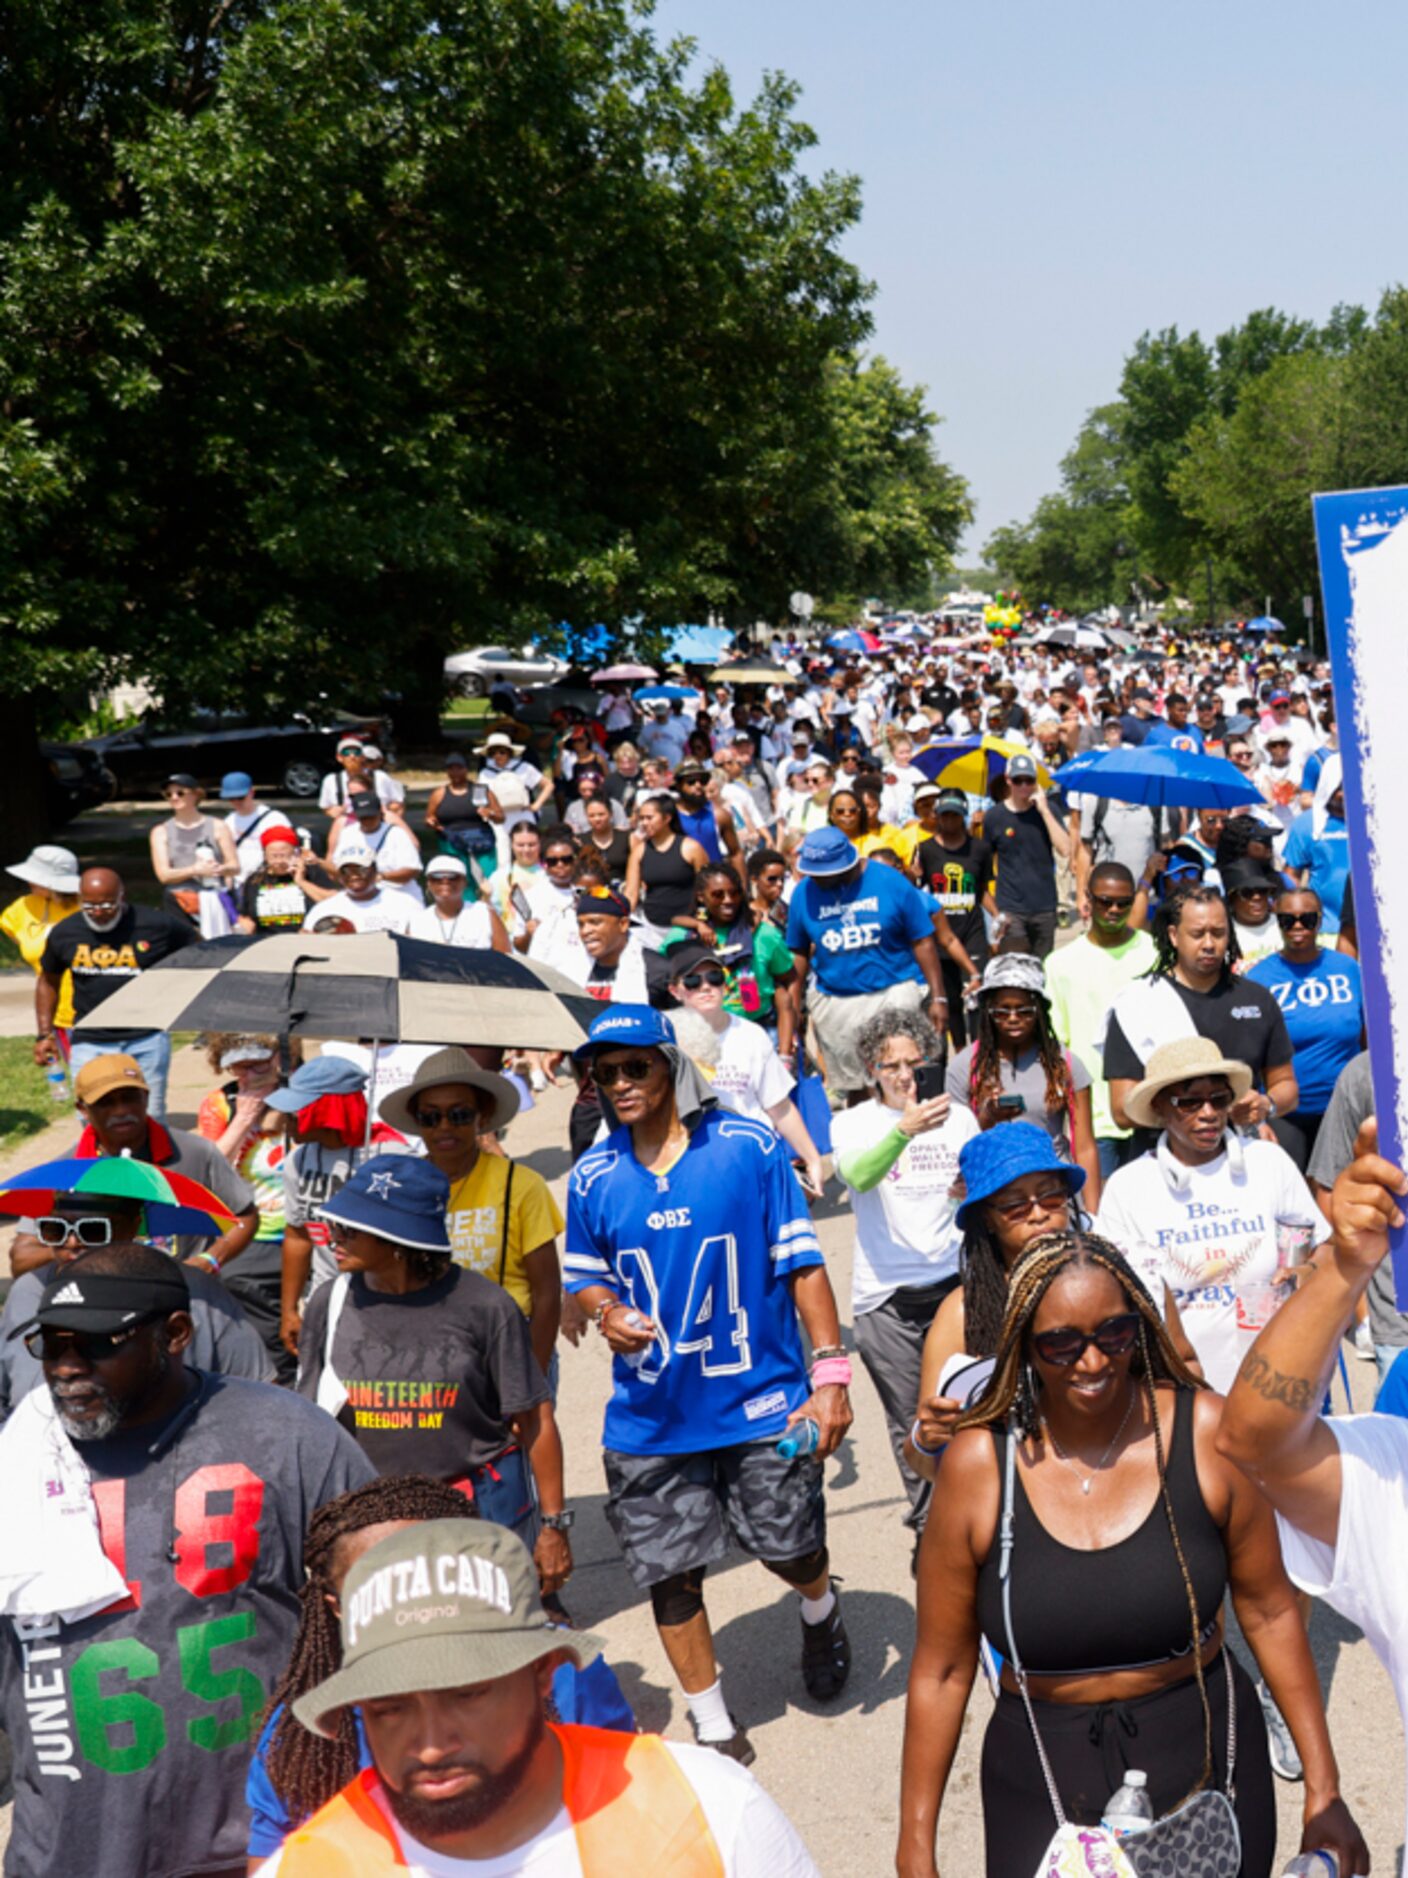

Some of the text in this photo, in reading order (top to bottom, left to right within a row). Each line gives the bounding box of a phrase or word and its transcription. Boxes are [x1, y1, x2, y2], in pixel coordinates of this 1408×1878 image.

[821, 922, 881, 952] ΦΒΣ
[1156, 1214, 1266, 1248] Faithful
[1205, 1247, 1227, 1261] in
[355, 1410, 445, 1430] FREEDOM DAY
[91, 1462, 265, 1616] 18
[349, 1553, 513, 1646] PUNTA CANA
[395, 1602, 460, 1627] Original
[69, 1610, 266, 1776] 65
